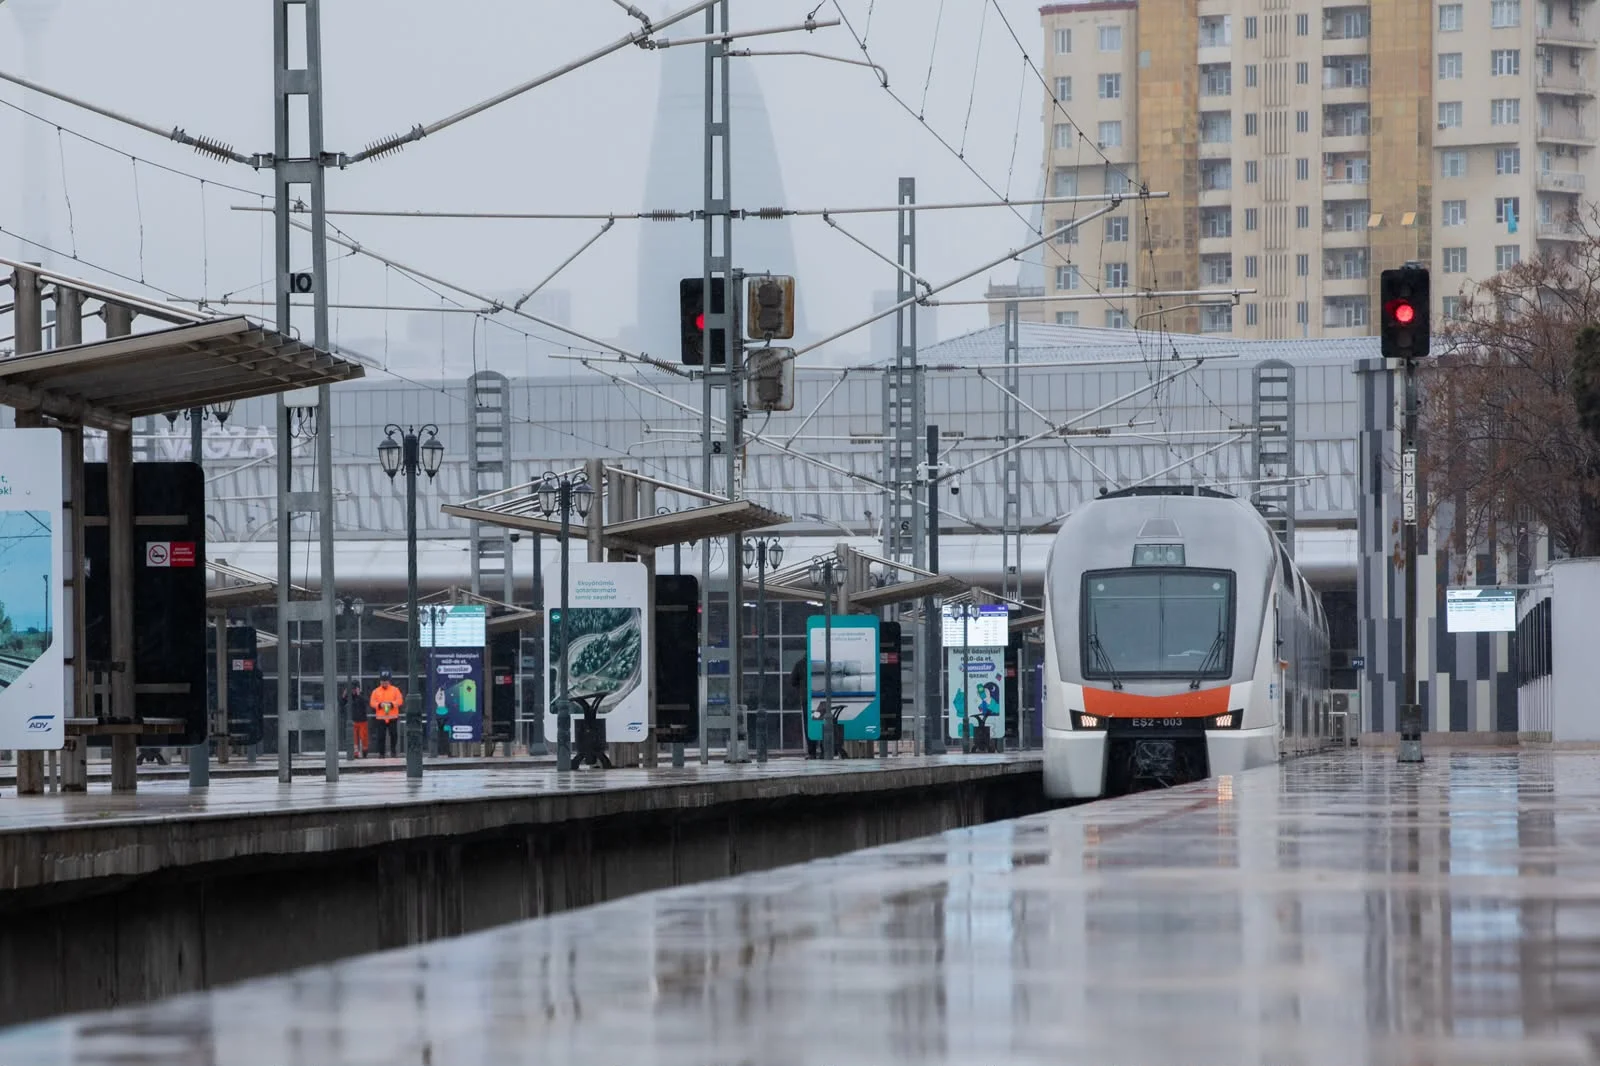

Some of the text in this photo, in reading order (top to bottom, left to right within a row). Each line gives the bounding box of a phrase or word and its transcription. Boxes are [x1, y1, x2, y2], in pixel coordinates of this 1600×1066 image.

[713, 441, 721, 453] 8
[901, 520, 910, 531] 6
[1163, 718, 1183, 726] 003
